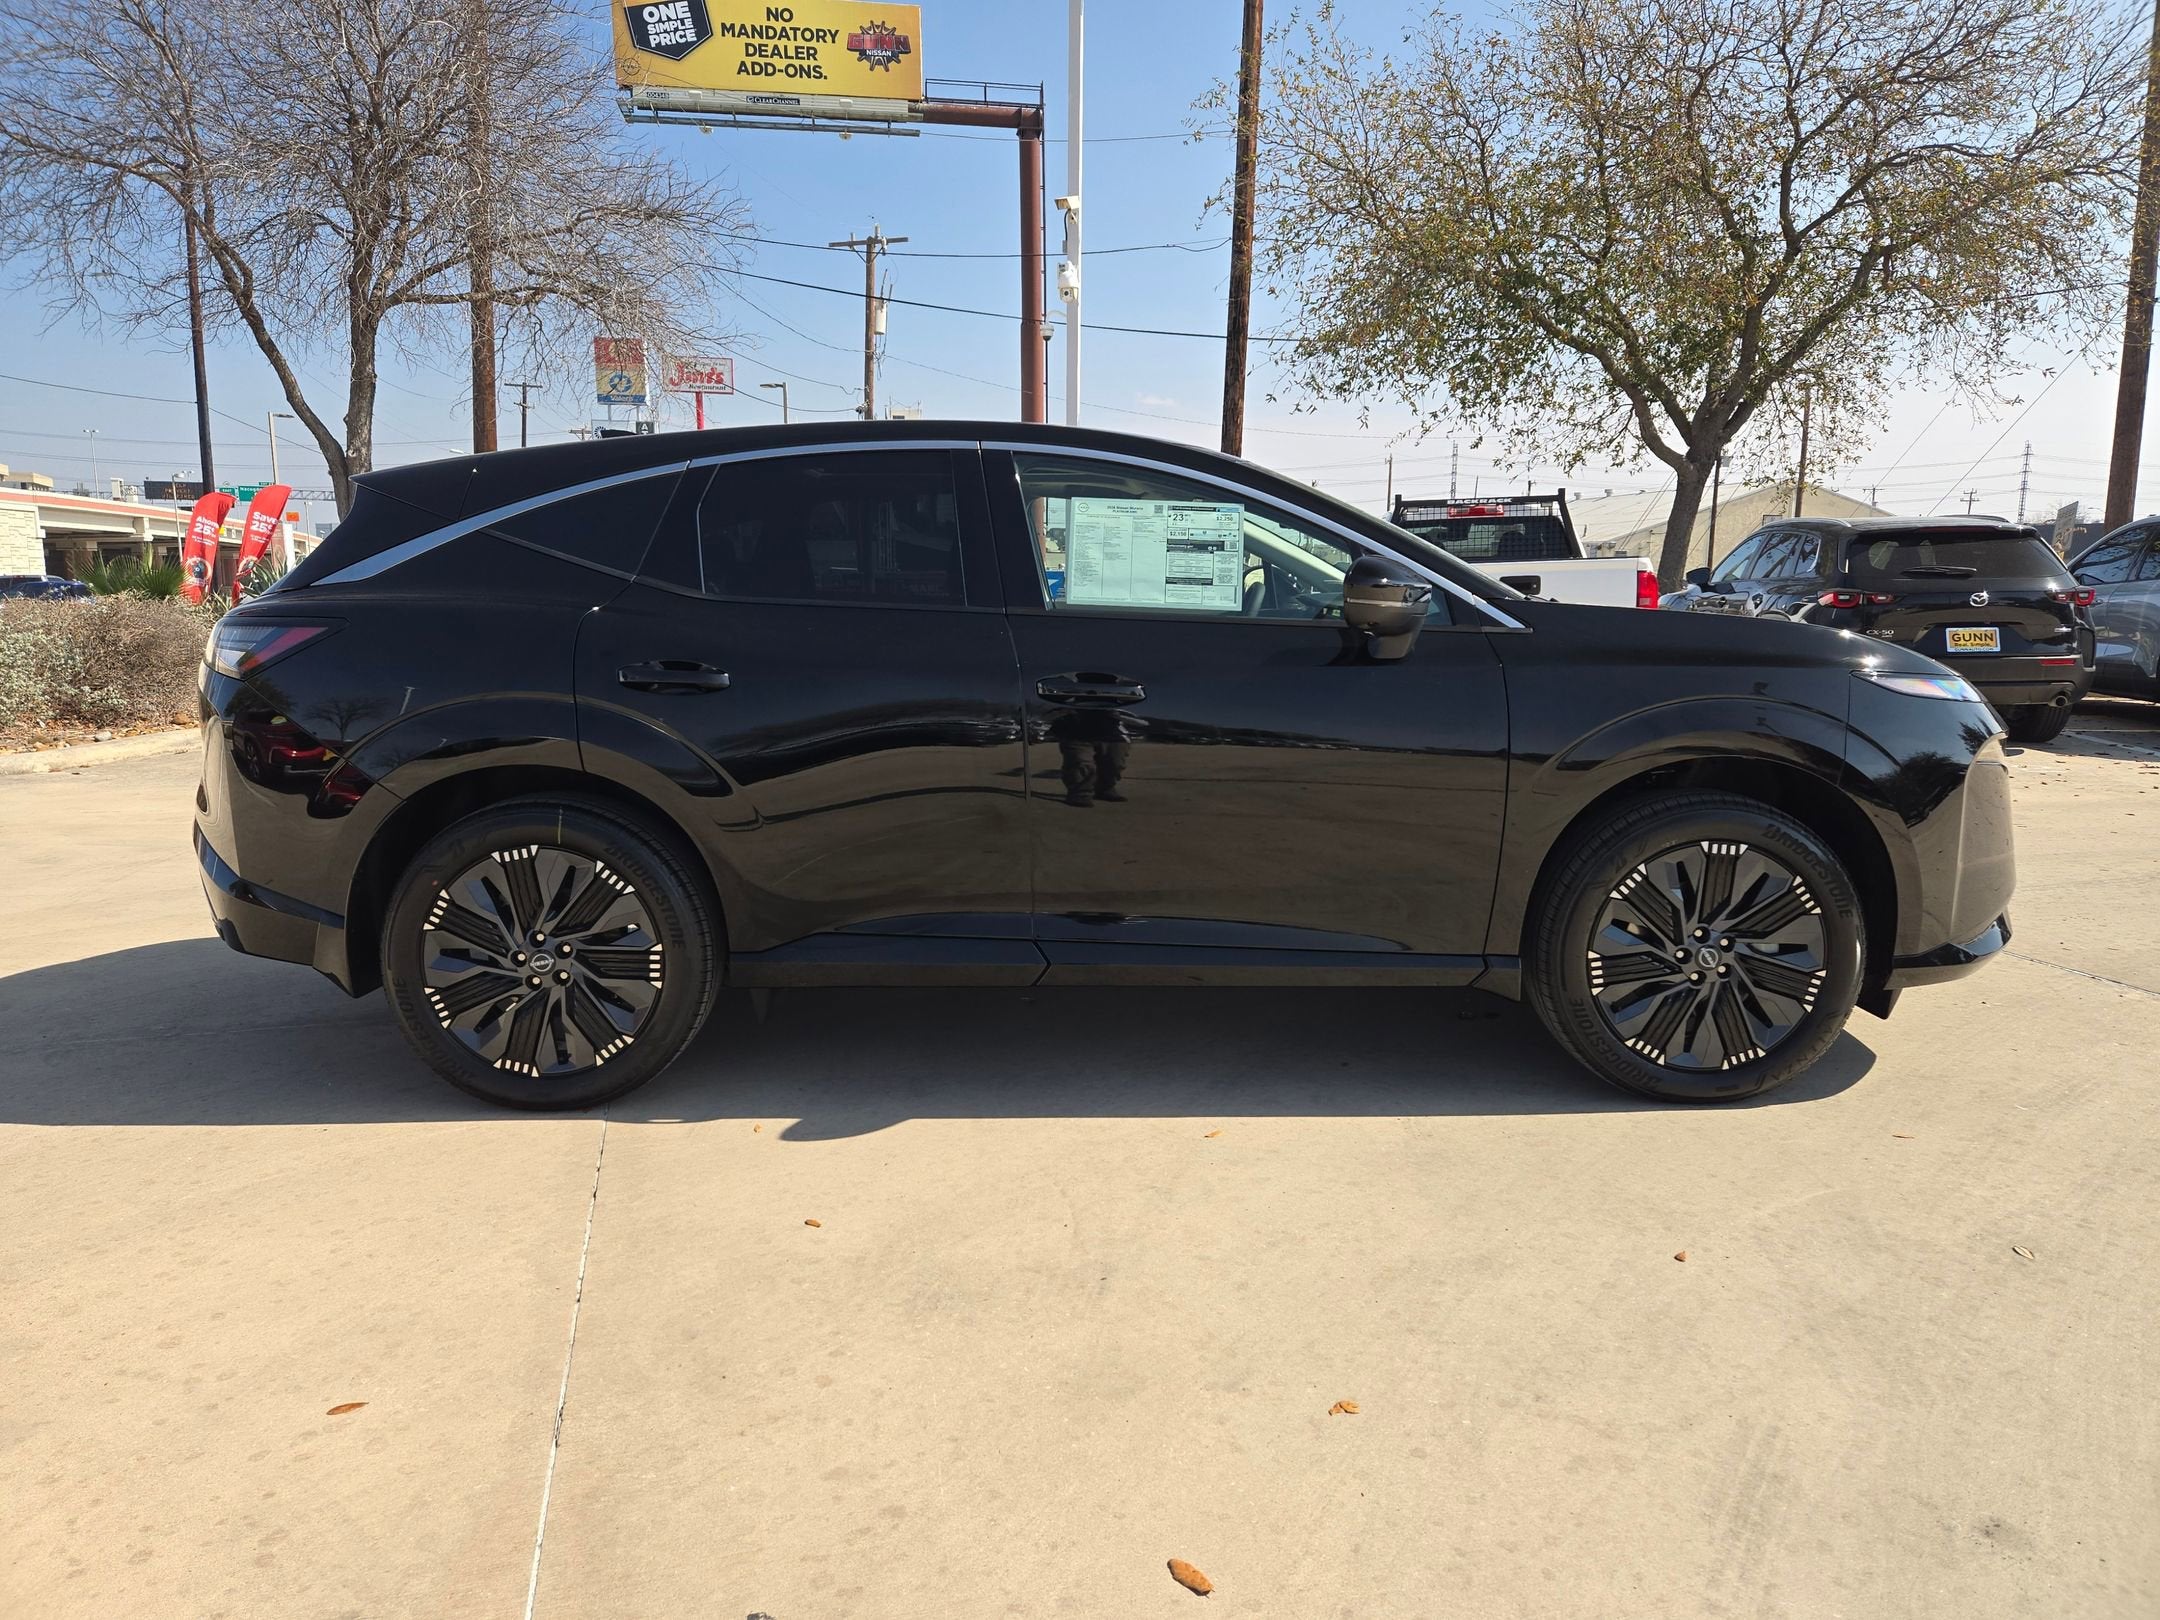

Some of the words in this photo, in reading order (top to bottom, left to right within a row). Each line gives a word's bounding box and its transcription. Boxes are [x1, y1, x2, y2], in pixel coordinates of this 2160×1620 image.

[643, 1, 691, 23] ONE
[766, 7, 794, 22] NO
[647, 18, 694, 34] SIMPLE
[721, 22, 840, 44] MANDATORY
[649, 29, 698, 48] PRICE
[847, 33, 912, 53] GUNN
[745, 42, 818, 61] DEALER
[737, 61, 828, 80] ADD-ONS.
[253, 511, 278, 525] Save
[1173, 513, 1184, 521] 23
[1951, 632, 1994, 642] GUNN
